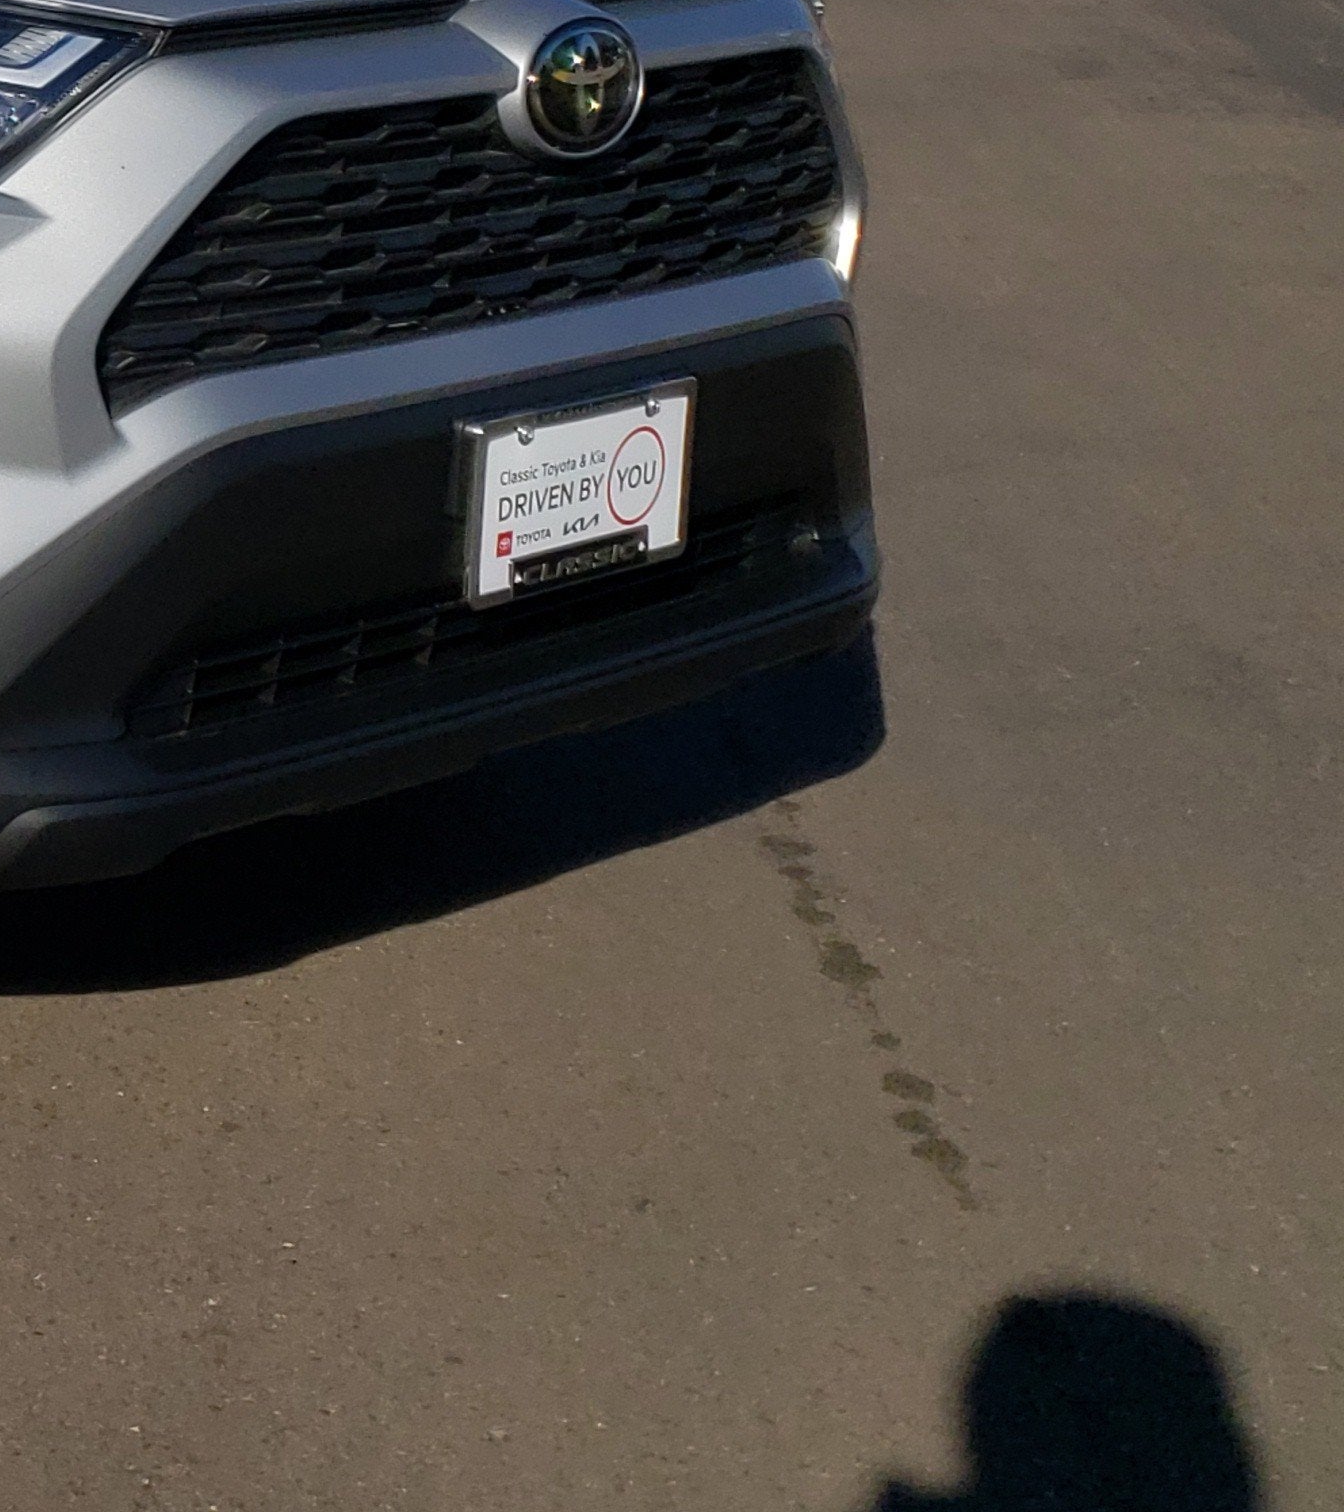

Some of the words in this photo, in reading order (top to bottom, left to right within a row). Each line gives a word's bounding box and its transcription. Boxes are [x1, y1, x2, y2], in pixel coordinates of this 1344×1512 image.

[500, 466, 538, 486] Classic
[542, 459, 577, 483] Toyota
[580, 454, 587, 469] &
[590, 450, 606, 466] Kia
[498, 481, 574, 522] DRIVEN
[579, 473, 605, 502] BY
[617, 460, 657, 492] YOU
[516, 529, 551, 546] TOYOTA
